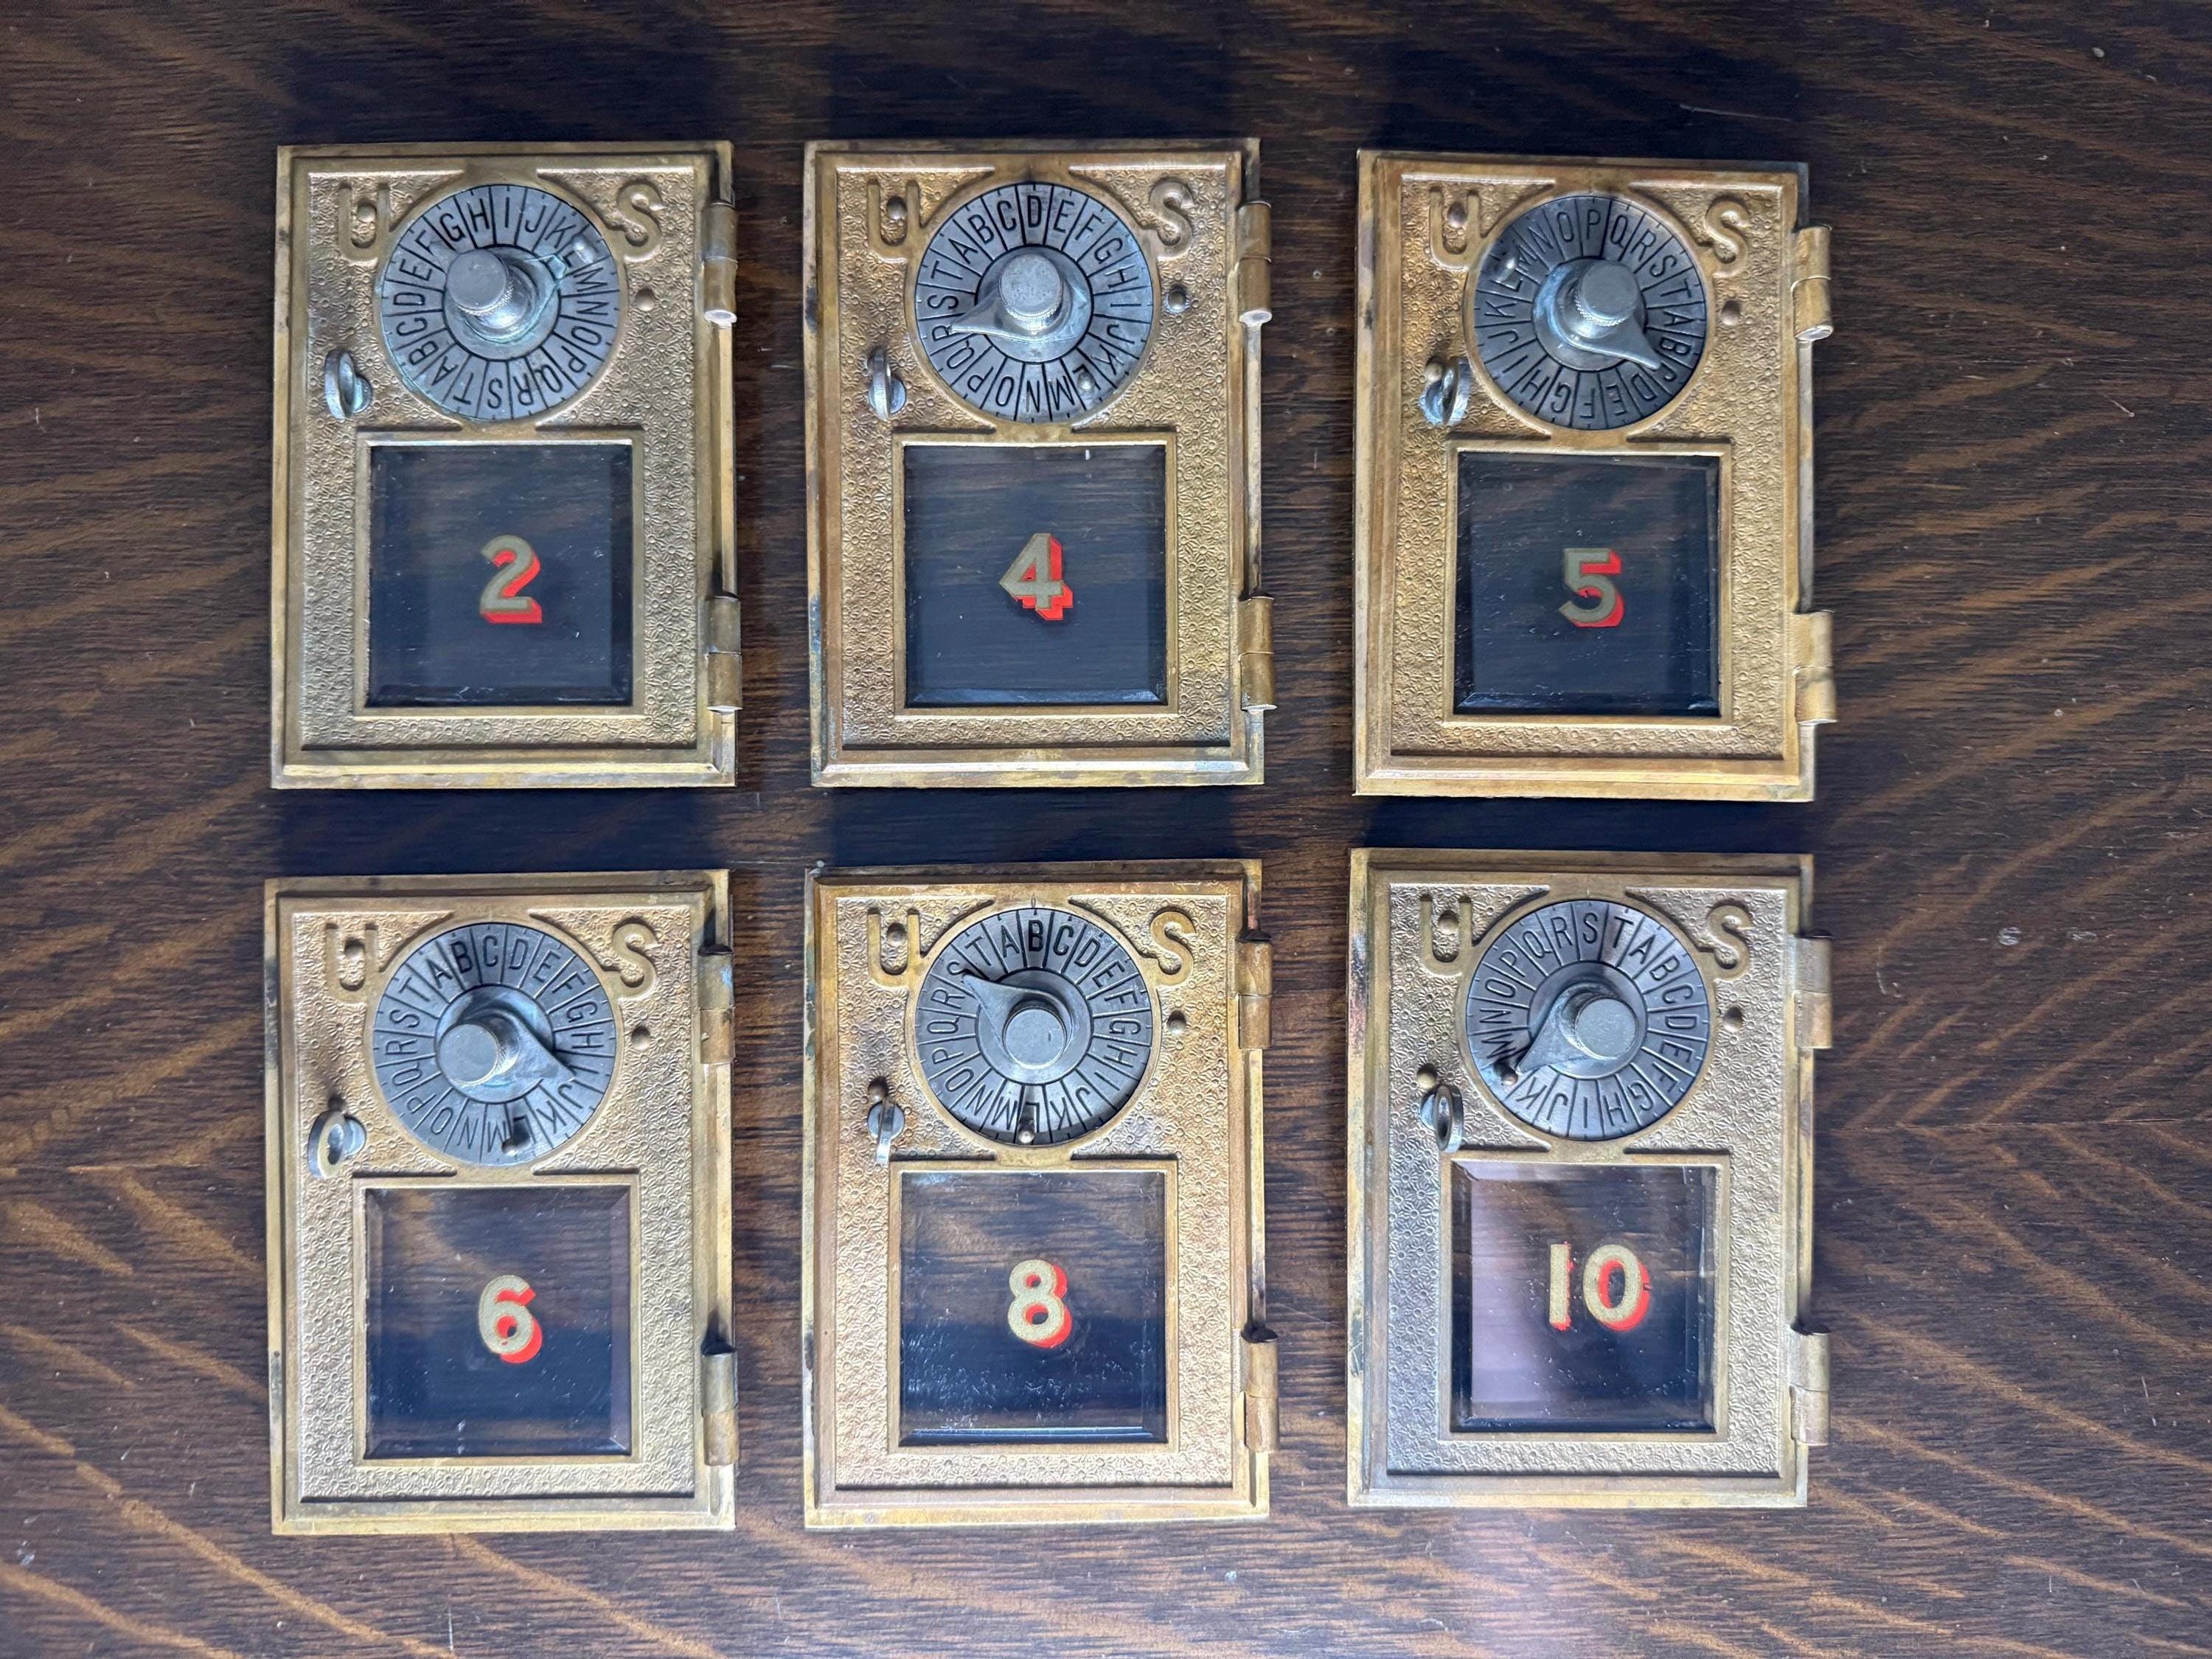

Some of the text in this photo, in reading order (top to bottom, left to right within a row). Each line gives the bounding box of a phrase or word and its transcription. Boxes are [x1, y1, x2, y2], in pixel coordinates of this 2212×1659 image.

[339, 177, 664, 260] U S
[467, 198, 490, 232] H
[504, 196, 511, 229] I
[524, 205, 546, 234] J
[868, 177, 1195, 261] U S
[996, 200, 1018, 232] C
[1027, 195, 1043, 228] D
[1053, 199, 1075, 234] E
[1074, 213, 1105, 241] F
[1557, 211, 1576, 243] O
[1586, 209, 1602, 240] P
[414, 229, 435, 256] F
[439, 212, 467, 243] G
[544, 215, 577, 249] K
[967, 213, 995, 245] B
[1430, 187, 1751, 276] U S
[1527, 225, 1554, 252] N
[1610, 214, 1630, 248] Q
[1630, 229, 1657, 255] R
[947, 237, 978, 265] A
[1093, 237, 1124, 265] G
[1649, 254, 1677, 278] S
[398, 258, 433, 282] E
[573, 266, 608, 295] M
[930, 260, 964, 281] T
[1104, 264, 1139, 288] H
[1489, 277, 1523, 293] L
[393, 291, 425, 306] D
[926, 294, 959, 310] S
[1660, 277, 1693, 299] T
[576, 299, 609, 316] N
[1484, 300, 1517, 319] K
[1663, 310, 1694, 327] A
[395, 316, 428, 336] C
[570, 326, 602, 347] O
[1106, 324, 1135, 344] J
[1487, 329, 1520, 344] J
[408, 340, 439, 366] B
[561, 345, 588, 374] P
[946, 339, 975, 370] Q
[1091, 344, 1125, 376] K
[1660, 335, 1691, 357] B
[431, 355, 459, 387] A
[533, 361, 564, 394] Q
[967, 366, 995, 394] P
[1071, 364, 1102, 391] L
[1500, 355, 1528, 374] I
[452, 372, 474, 406] T
[487, 378, 503, 409] S
[512, 375, 535, 406] R
[995, 375, 1015, 406] O
[1025, 379, 1041, 413] N
[1047, 375, 1076, 411] M
[1520, 369, 1550, 402] H
[1552, 383, 1572, 414] G
[1605, 382, 1627, 417] E
[1631, 372, 1658, 402] D
[1579, 388, 1596, 420] F
[480, 535, 543, 624] 2
[998, 533, 1074, 621] 4
[1558, 547, 1625, 628] 5
[1001, 925, 1020, 958] A
[1027, 919, 1044, 953] B
[1052, 925, 1074, 956] C
[1419, 894, 1753, 982] U S
[1550, 917, 1573, 950] R
[1582, 911, 1599, 945] S
[1612, 915, 1635, 949] T
[450, 941, 474, 973] B
[482, 935, 498, 967] C
[508, 938, 529, 970] D
[867, 905, 1196, 989] U S
[964, 934, 992, 967] T
[1074, 937, 1101, 967] D
[1523, 930, 1554, 959] Q
[1627, 933, 1656, 965] A
[324, 917, 660, 1004] U S
[425, 958, 453, 989] A
[532, 949, 561, 984] E
[1091, 959, 1126, 988] E
[1499, 950, 1526, 978] P
[1650, 955, 1681, 981] B
[398, 976, 431, 1002] T
[551, 971, 587, 995] F
[930, 987, 966, 1010] R
[1104, 988, 1139, 1006] F
[1484, 978, 1517, 998] O
[1661, 984, 1694, 1004] C
[389, 1009, 421, 1029] S
[566, 1001, 599, 1023] G
[926, 1017, 960, 1034] Q
[1108, 1018, 1142, 1035] G
[1479, 1008, 1512, 1023] N
[1665, 1014, 1697, 1030] D
[385, 1039, 418, 1056] R
[571, 1032, 605, 1049] H
[931, 1046, 964, 1065] P
[1103, 1043, 1138, 1068] H
[1479, 1037, 1517, 1060] M
[1659, 1039, 1694, 1064] E
[392, 1060, 423, 1087] Q
[945, 1067, 975, 1093] O
[1093, 1071, 1121, 1091] I
[1652, 1060, 1682, 1093] F
[406, 1091, 437, 1115] P
[557, 1083, 584, 1110] J
[964, 1083, 995, 1116] N
[1074, 1085, 1093, 1118] J
[1514, 1076, 1548, 1110] K
[1546, 1093, 1569, 1121] J
[1627, 1079, 1655, 1111] G
[429, 1107, 453, 1135] O
[536, 1099, 567, 1135] K
[991, 1096, 1018, 1131] M
[1025, 1102, 1040, 1133] L
[1049, 1096, 1074, 1131] K
[1601, 1093, 1627, 1127] H
[456, 1117, 479, 1150] N
[487, 1120, 508, 1153] M
[512, 1113, 538, 1145] L
[1549, 1242, 1652, 1332] 10
[479, 1274, 543, 1364] 6
[1007, 1259, 1072, 1349] 8
